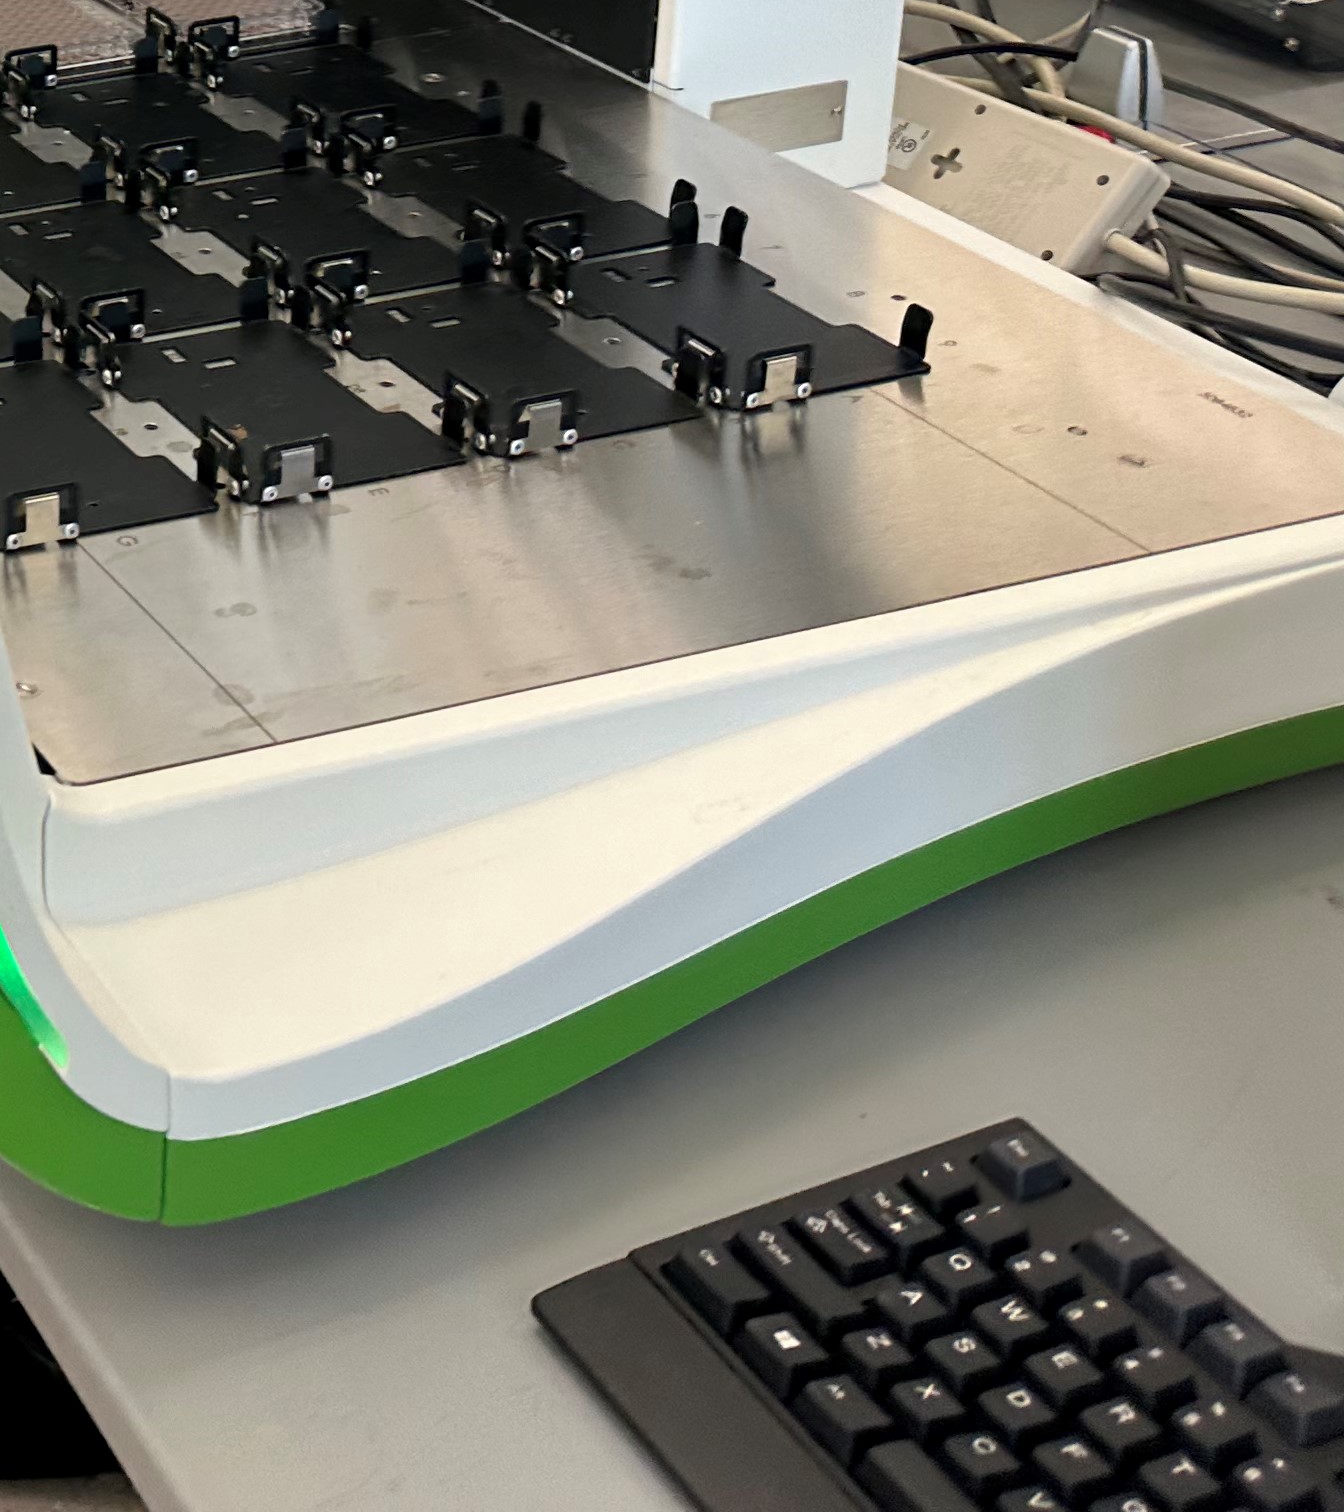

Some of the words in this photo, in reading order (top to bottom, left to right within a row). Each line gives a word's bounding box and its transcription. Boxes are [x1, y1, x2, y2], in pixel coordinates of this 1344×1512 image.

[949, 1254, 973, 1272] Q
[899, 1290, 924, 1306] A
[1001, 1299, 1030, 1322] W
[953, 1337, 977, 1354] S
[1052, 1350, 1078, 1369] E
[915, 1384, 941, 1400] X
[1006, 1389, 1032, 1409] D
[1109, 1401, 1137, 1424] R
[1061, 1442, 1089, 1460] F
[1171, 1456, 1197, 1475] T
[1027, 1491, 1056, 1508] V
